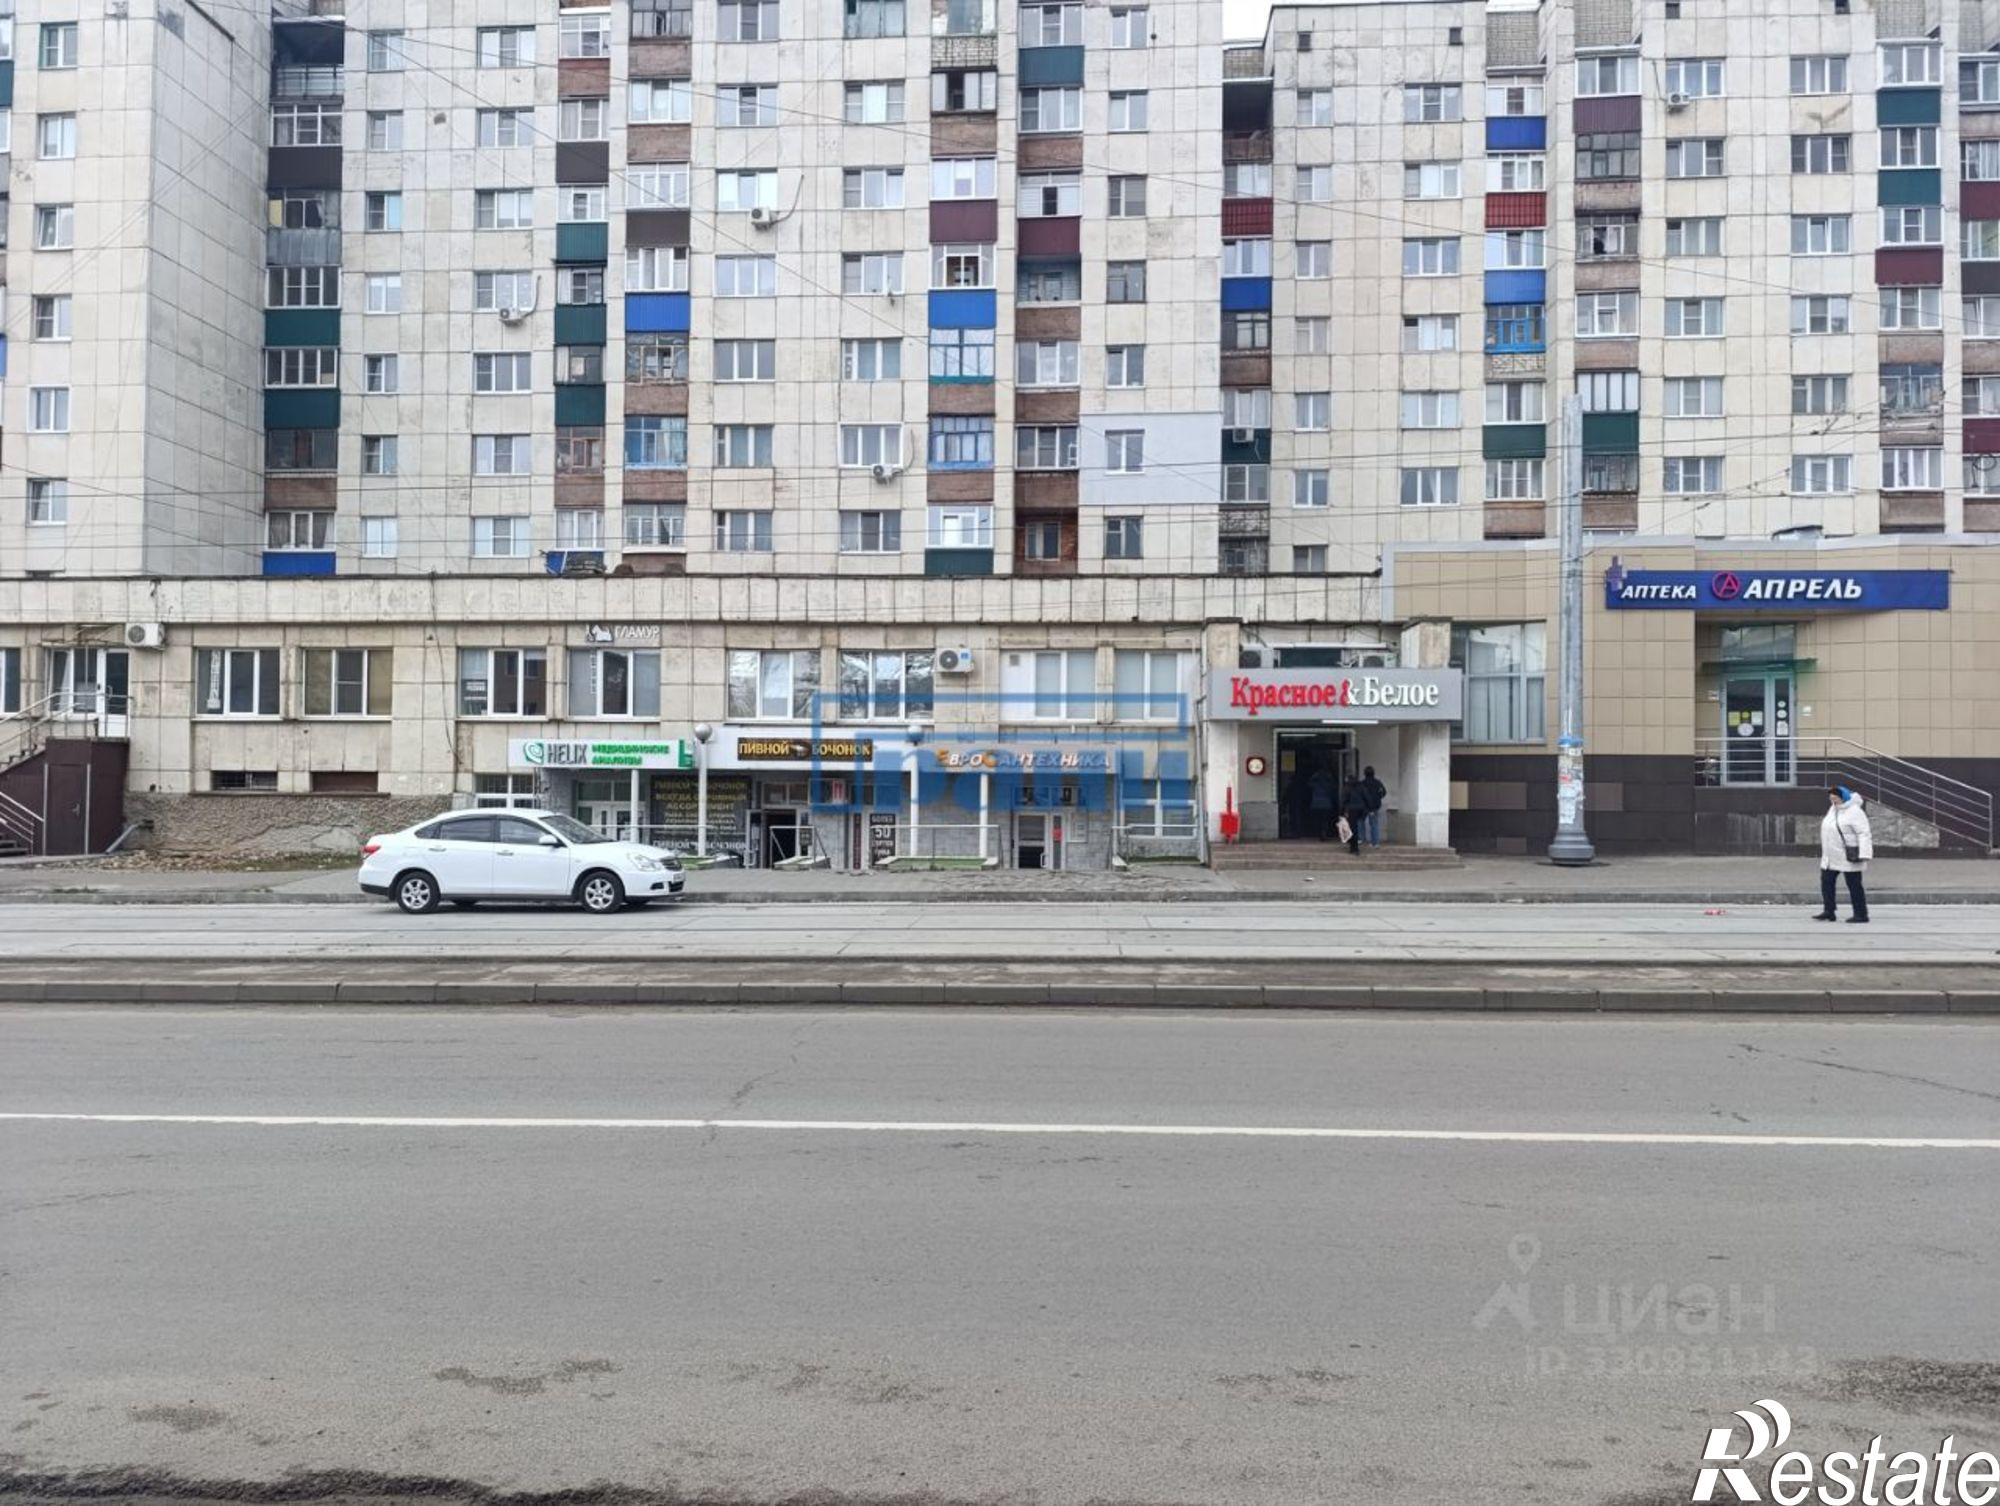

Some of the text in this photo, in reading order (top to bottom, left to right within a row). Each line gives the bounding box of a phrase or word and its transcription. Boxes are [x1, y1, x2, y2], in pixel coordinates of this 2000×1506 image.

[1621, 584, 1697, 600] АПТЕКА
[1743, 578, 1863, 600] АПРЕЛЬ
[614, 625, 660, 641] ГЛАМУР
[547, 743, 588, 765] HELIX
[738, 740, 872, 756] ПИВНОЙ БОЧОНОК
